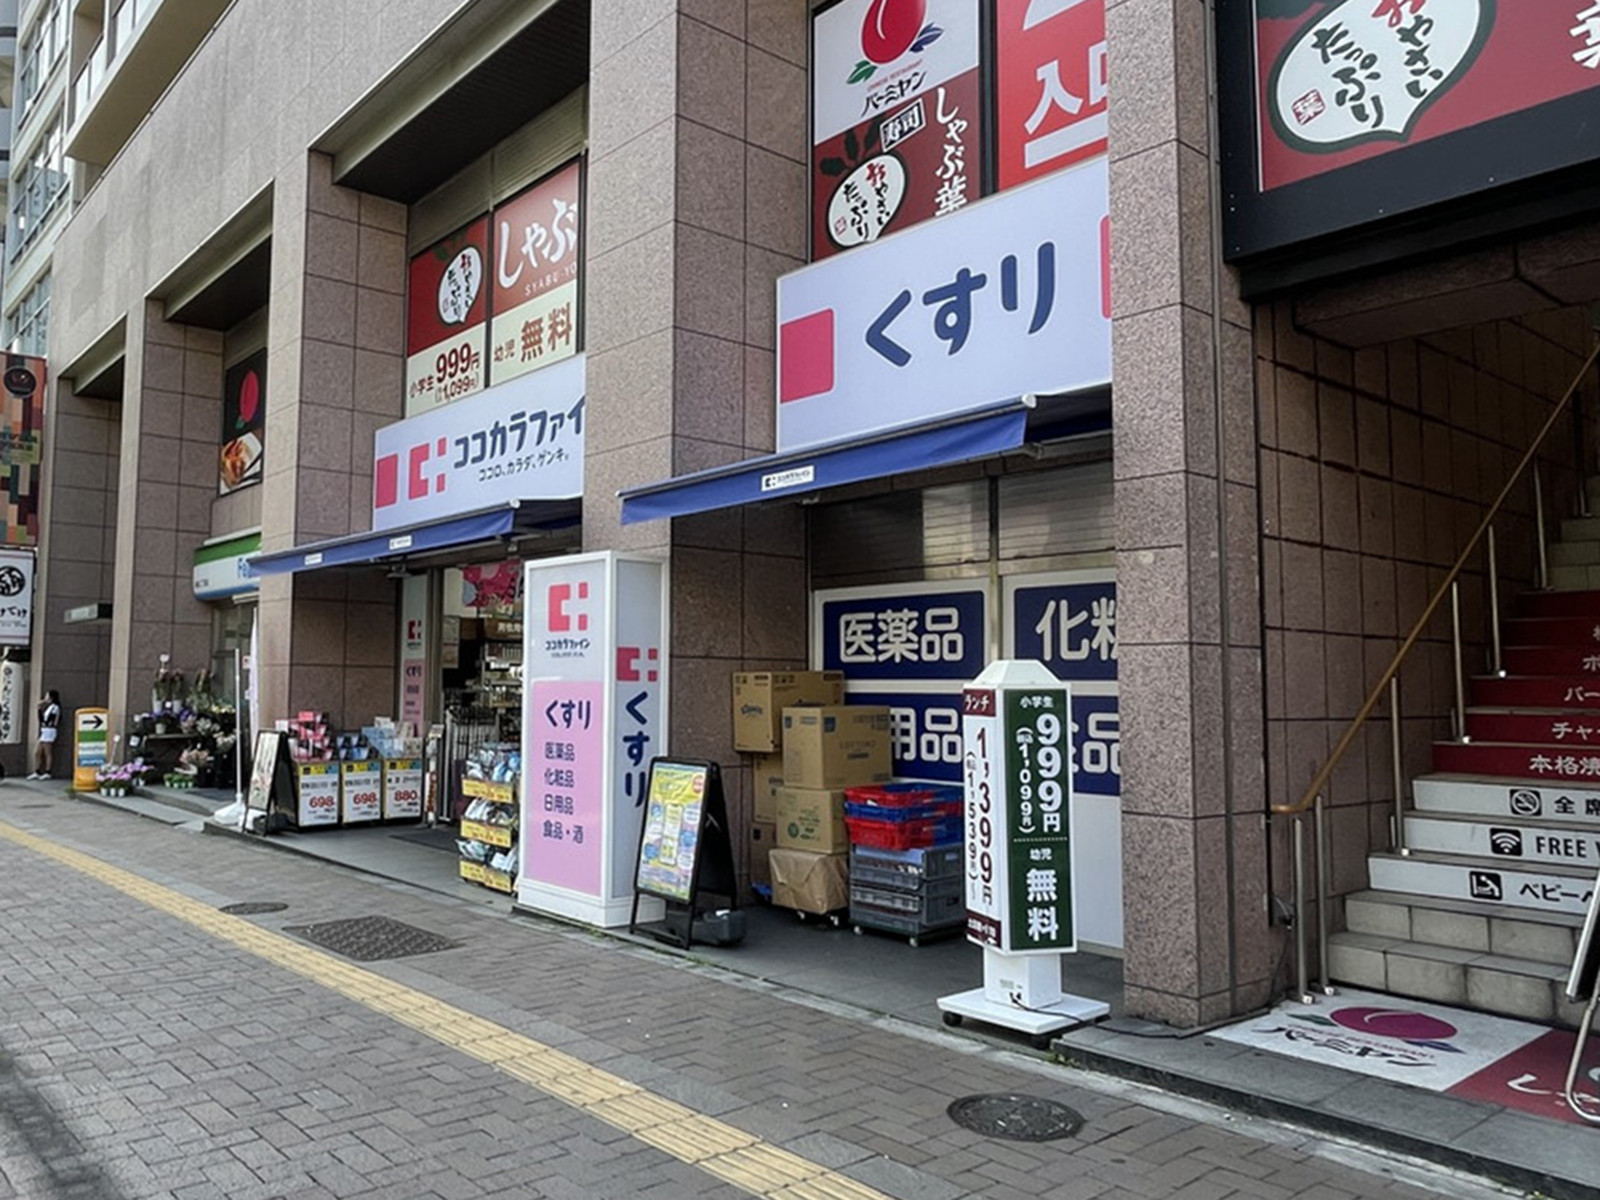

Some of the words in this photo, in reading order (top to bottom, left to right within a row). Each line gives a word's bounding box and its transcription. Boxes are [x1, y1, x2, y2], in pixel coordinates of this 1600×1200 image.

[861, 71, 926, 117] バーミヤン
[1311, 21, 1384, 128] たっぷり
[935, 86, 968, 217] しゃぶ葉
[843, 181, 869, 240] たっぷり
[866, 163, 890, 226] おやさい
[499, 198, 577, 288] しゃぶ
[521, 302, 572, 362] 無料
[866, 238, 1055, 368] くすり
[436, 342, 480, 384] 999円
[454, 396, 585, 469] ココカラファイ
[839, 607, 964, 663] 医薬品
[545, 699, 591, 730] くすり
[964, 695, 990, 712] ランチ
[1020, 695, 1054, 709] 小学生
[1551, 721, 1600, 741] チャ
[544, 768, 574, 788] 化粧品
[545, 741, 575, 762] 医薬品
[622, 690, 650, 808] くすり
[1036, 713, 1063, 833] 999円
[544, 794, 574, 815] 日用品
[977, 727, 993, 907] 1,399円
[1535, 836, 1588, 859] FREE
[1025, 867, 1058, 942] 無料
